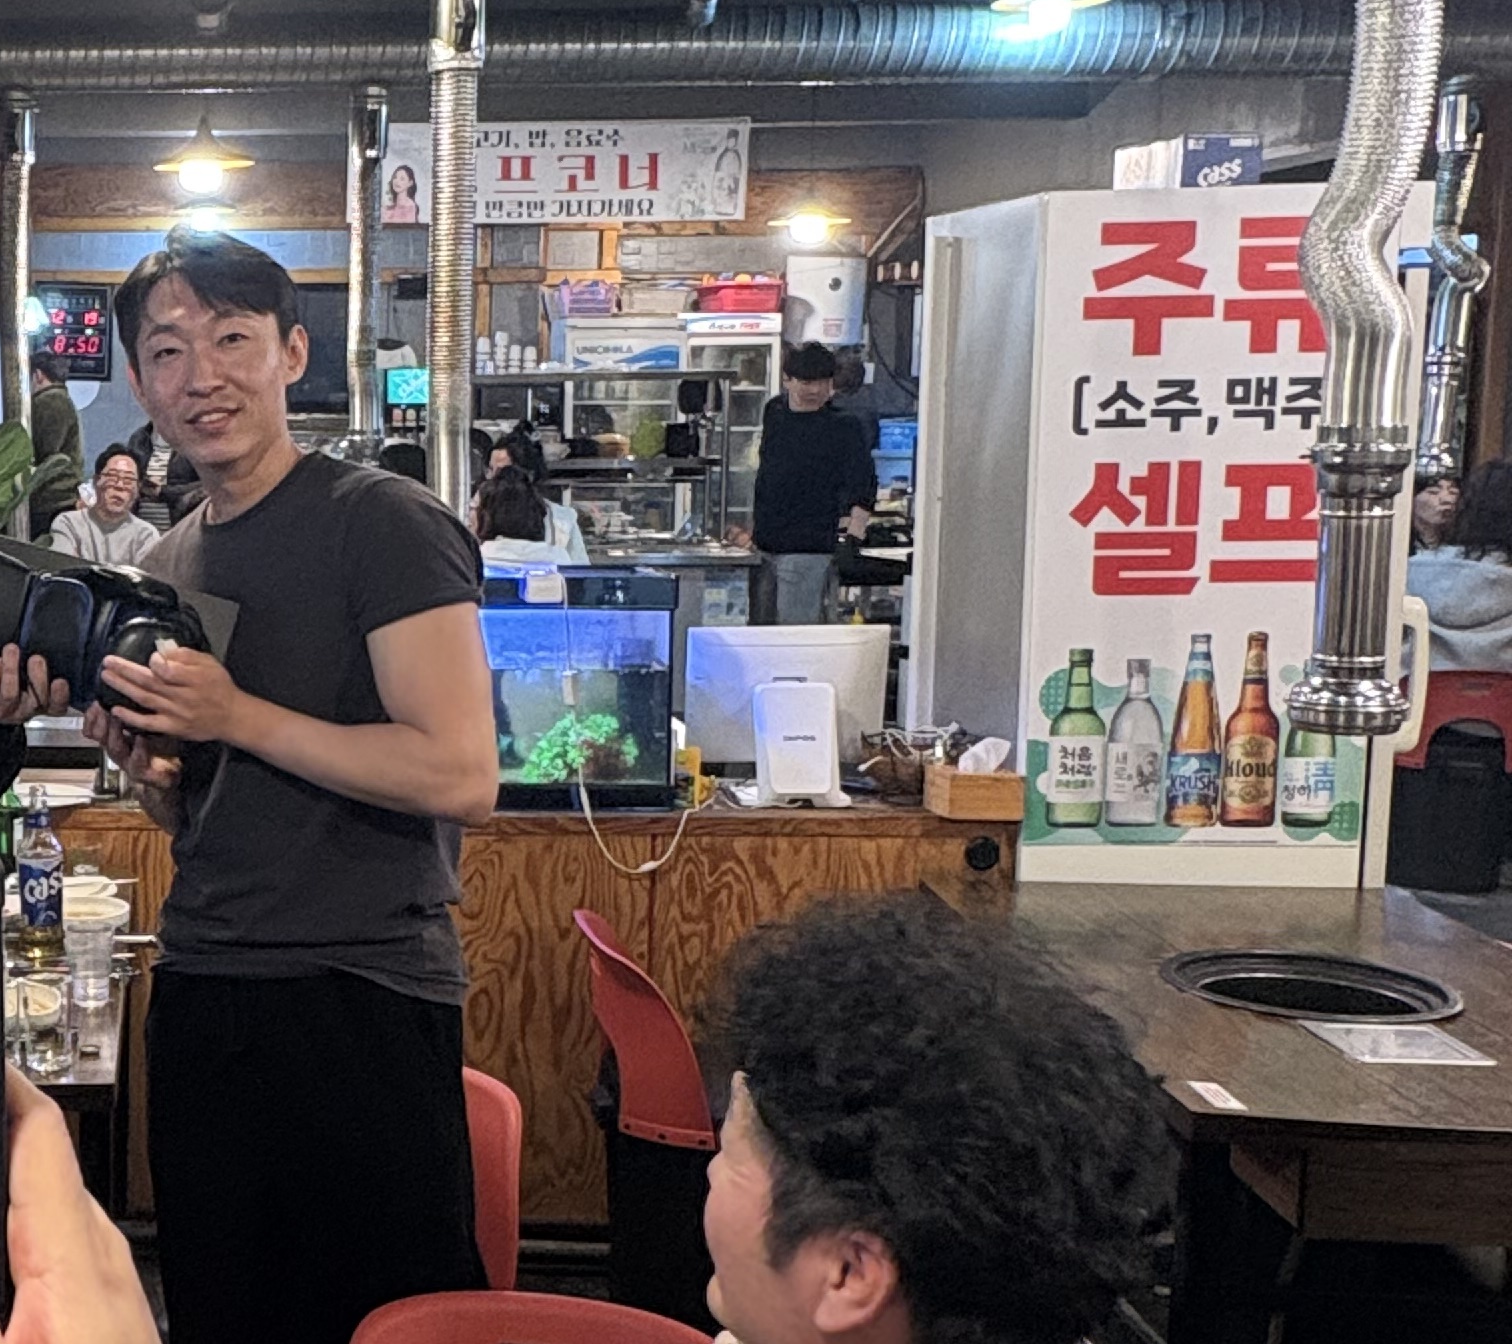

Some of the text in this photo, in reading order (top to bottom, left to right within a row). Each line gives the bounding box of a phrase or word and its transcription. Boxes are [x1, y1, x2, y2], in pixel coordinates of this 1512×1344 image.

[491, 152, 661, 194] 프코너
[564, 128, 625, 148] 음료수
[1083, 216, 1327, 357] 주류
[1068, 460, 1320, 597] 셀프
